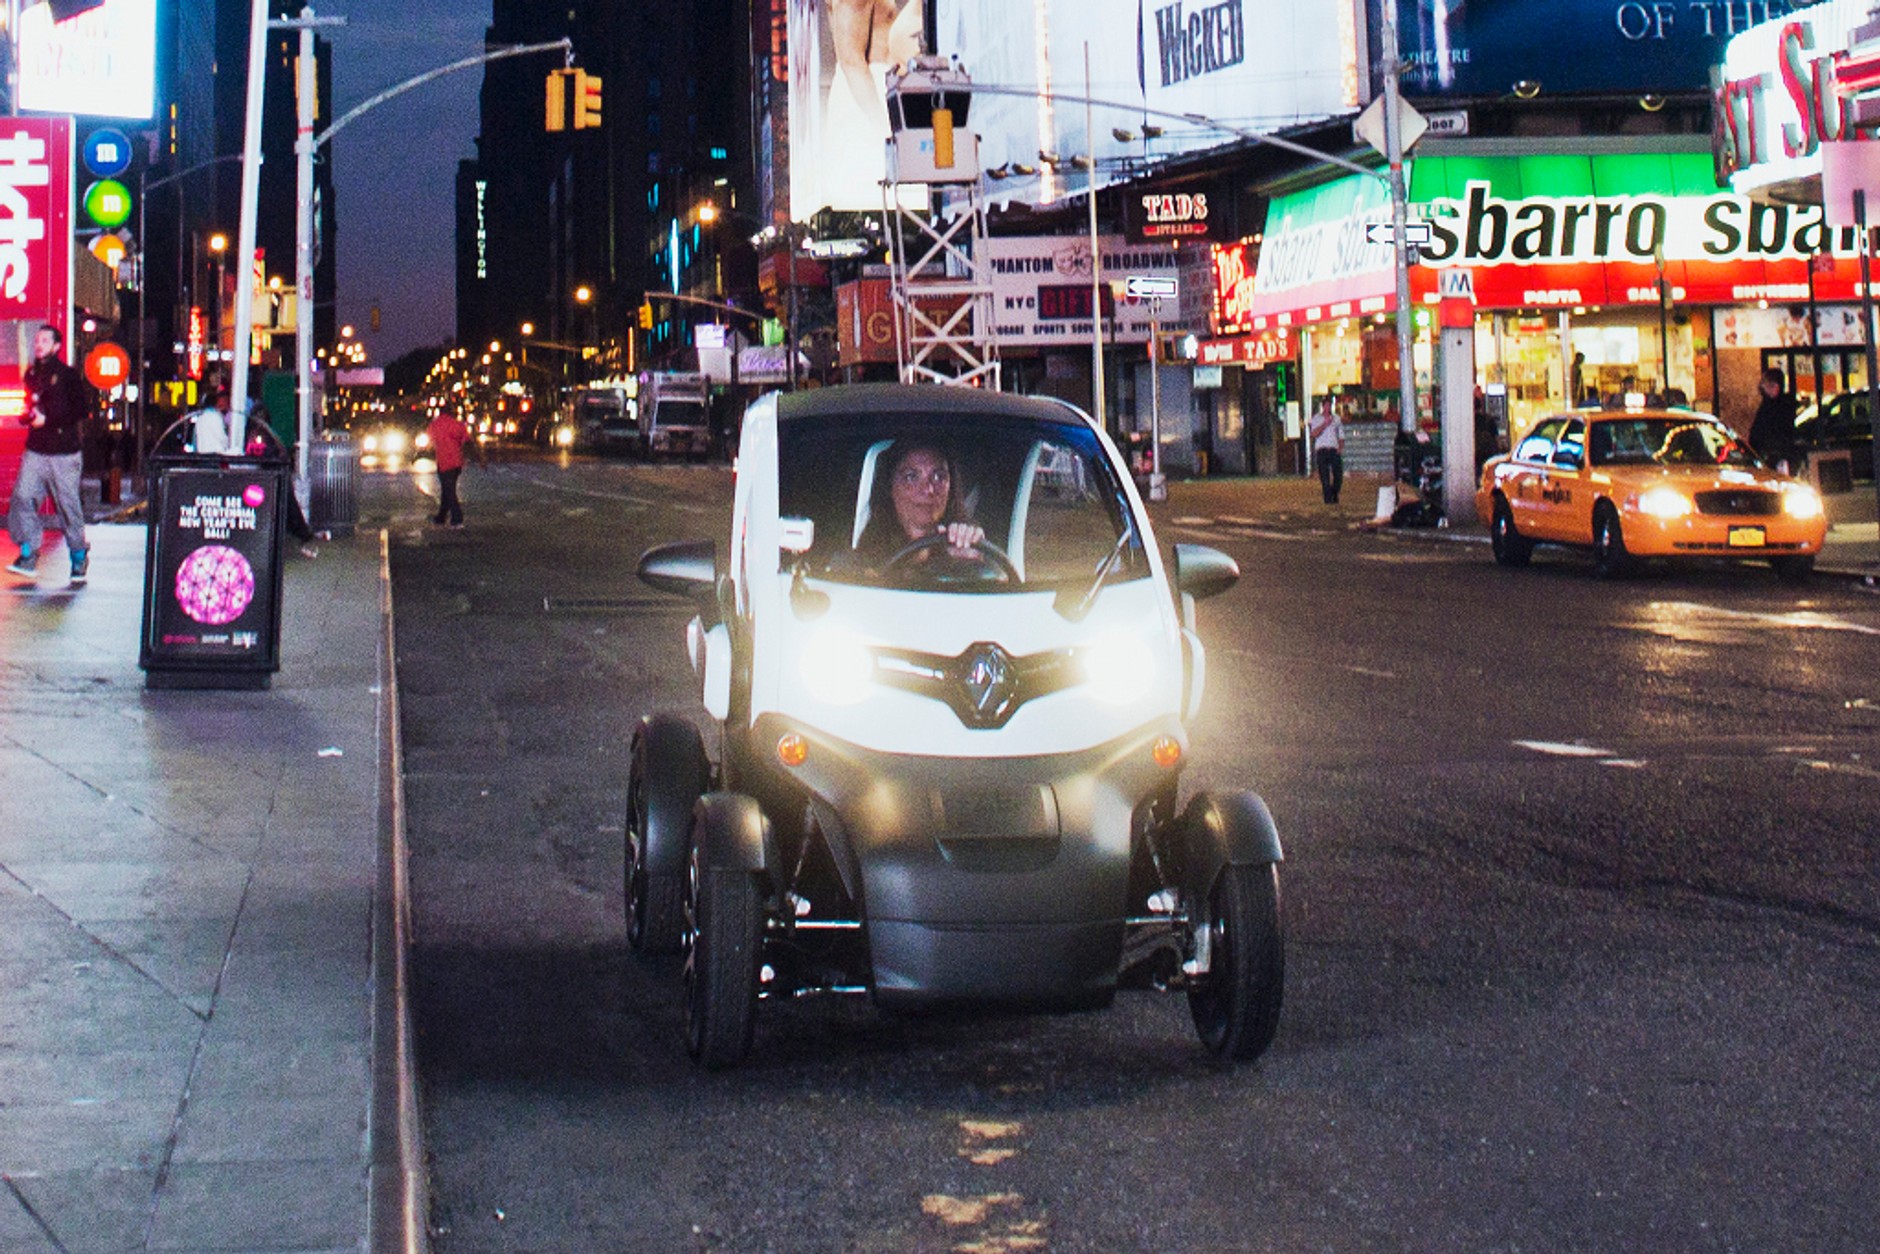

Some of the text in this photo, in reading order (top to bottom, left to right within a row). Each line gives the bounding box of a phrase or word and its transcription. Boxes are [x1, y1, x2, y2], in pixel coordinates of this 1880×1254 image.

[1617, 1, 1782, 39] OF THE
[1407, 49, 1470, 64] THERE
[97, 144, 118, 162] m
[103, 195, 121, 212] m
[476, 181, 487, 278] WELLINGTON
[1418, 187, 1880, 262] sbarro sba
[1627, 287, 1686, 300] SALD
[1005, 297, 1035, 309] NYC
[1244, 338, 1288, 359] TAD'S
[100, 356, 120, 375] m
[195, 496, 222, 507] COME
[180, 505, 198, 516] THE
